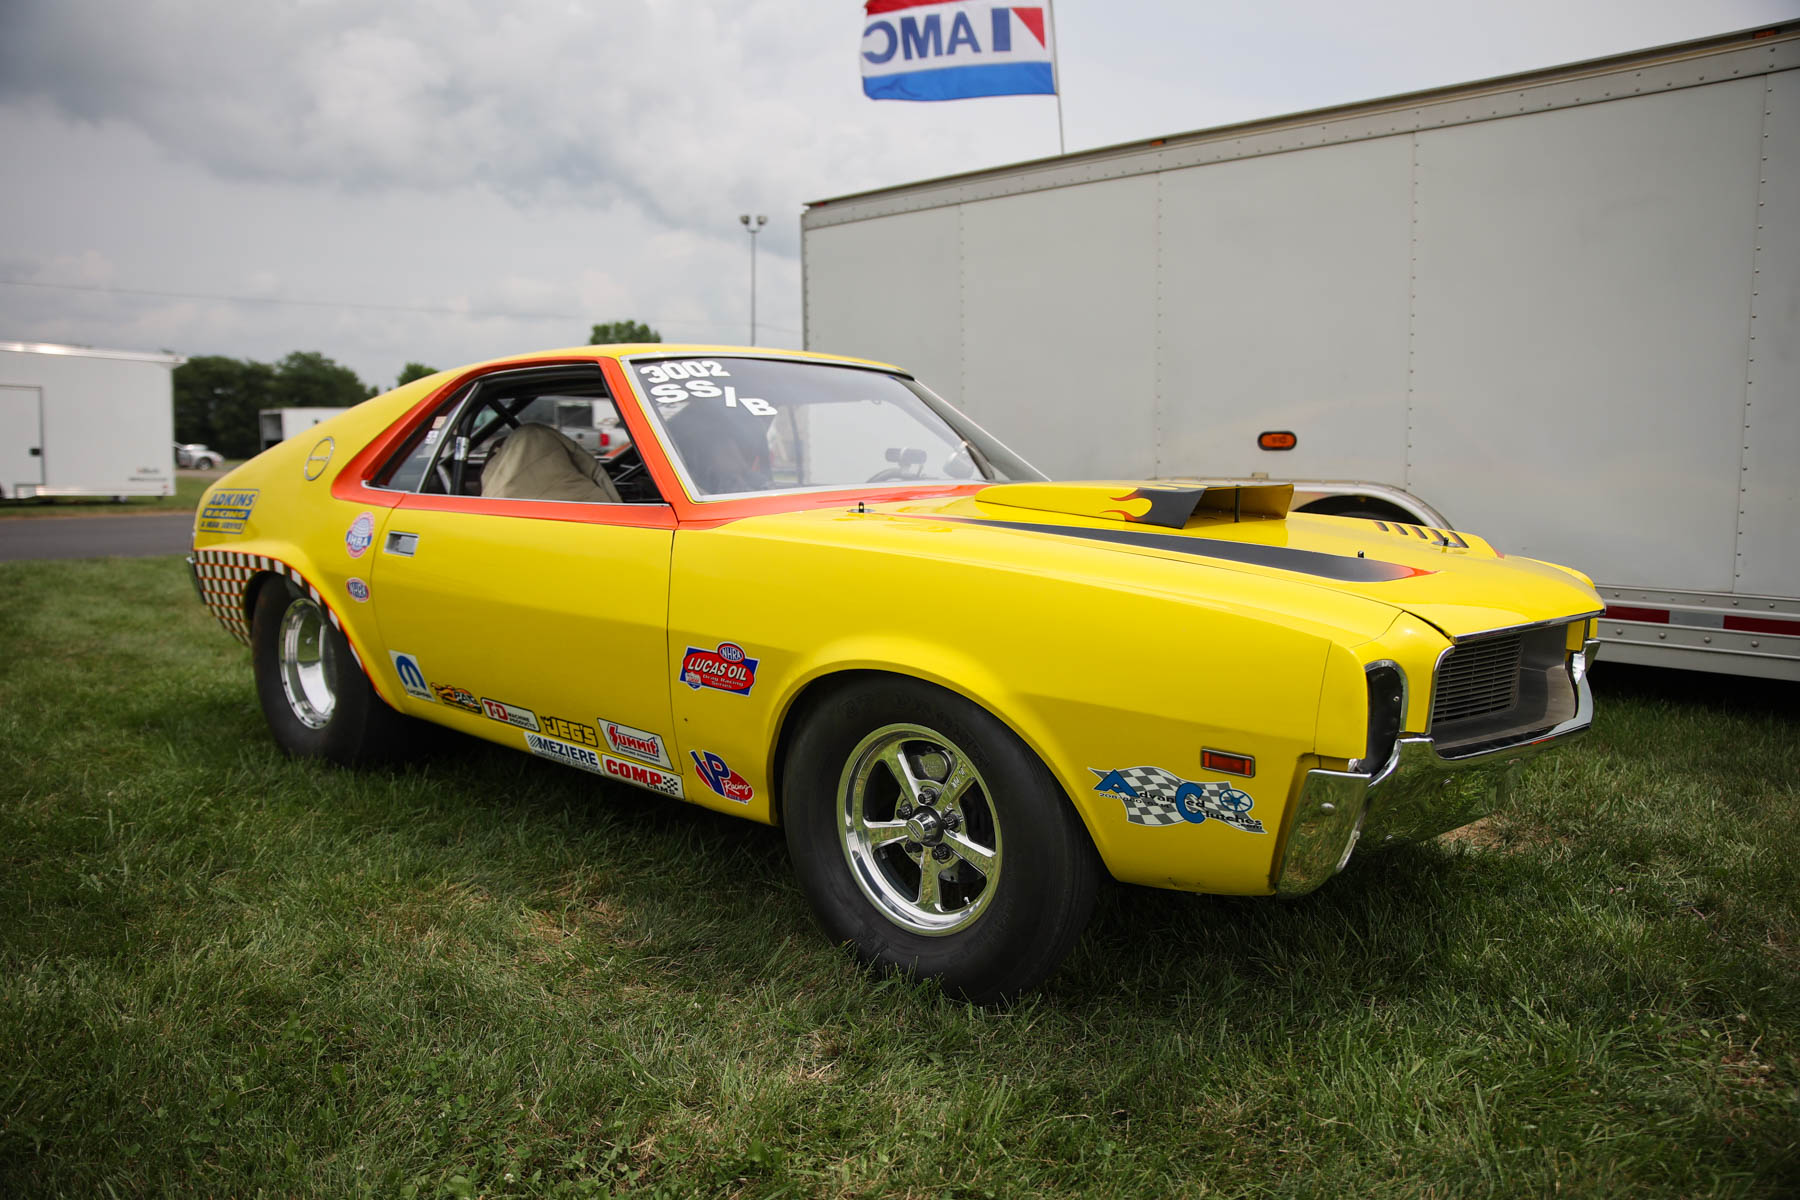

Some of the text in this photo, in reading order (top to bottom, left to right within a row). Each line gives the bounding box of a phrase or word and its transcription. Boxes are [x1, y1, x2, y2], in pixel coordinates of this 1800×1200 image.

[639, 360, 731, 384] 3002
[208, 493, 256, 507] ADKINS
[720, 646, 743, 661] NHRA
[687, 657, 747, 681] LUCAS OIL
[537, 737, 599, 766] MEZIERE
[605, 758, 663, 786] COMP
[689, 750, 731, 798] VP
[646, 782, 677, 796] CAMS
[723, 780, 752, 796] Racing
